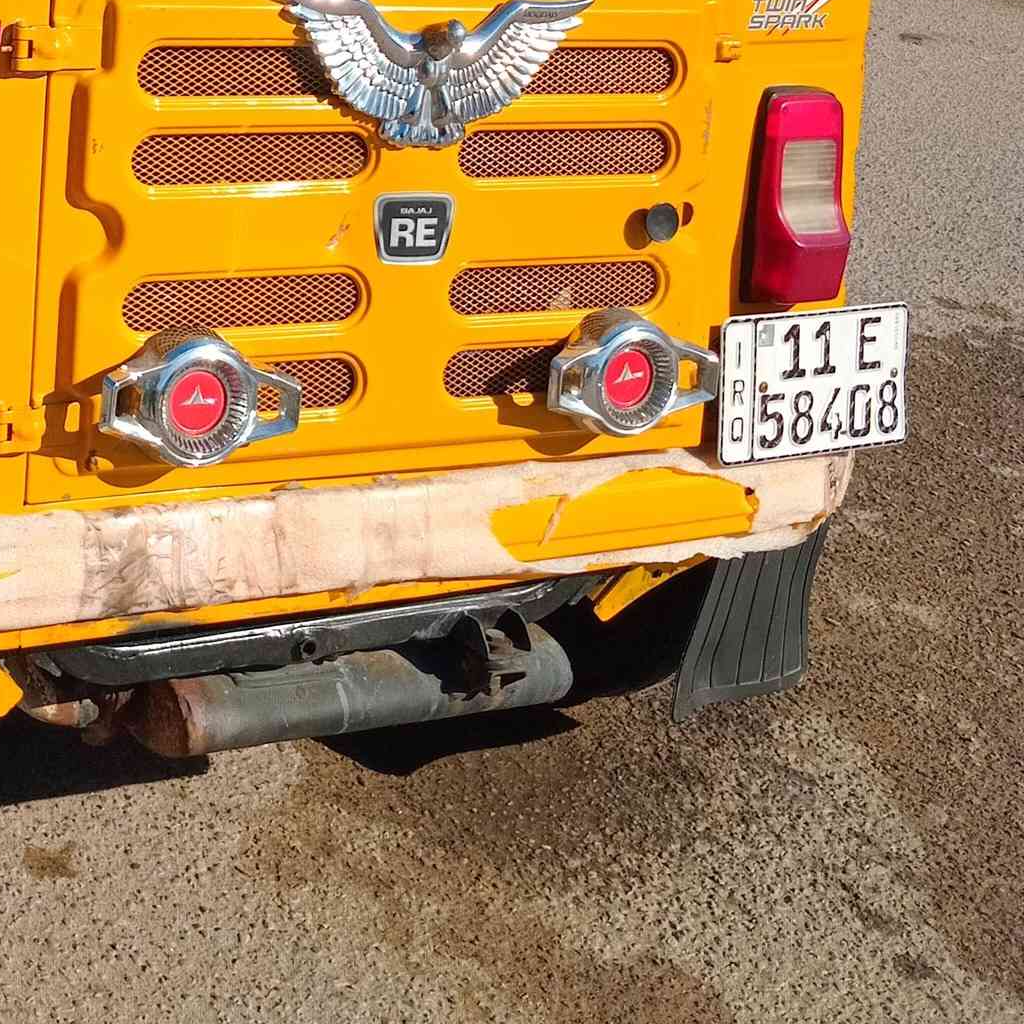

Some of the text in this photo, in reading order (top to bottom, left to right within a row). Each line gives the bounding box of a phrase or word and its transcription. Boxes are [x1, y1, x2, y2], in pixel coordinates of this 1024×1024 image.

[748, 13, 828, 29] SPARK
[390, 218, 438, 247] RE
[782, 321, 836, 380] 11
[858, 316, 882, 370] E
[758, 379, 899, 450] 58408
